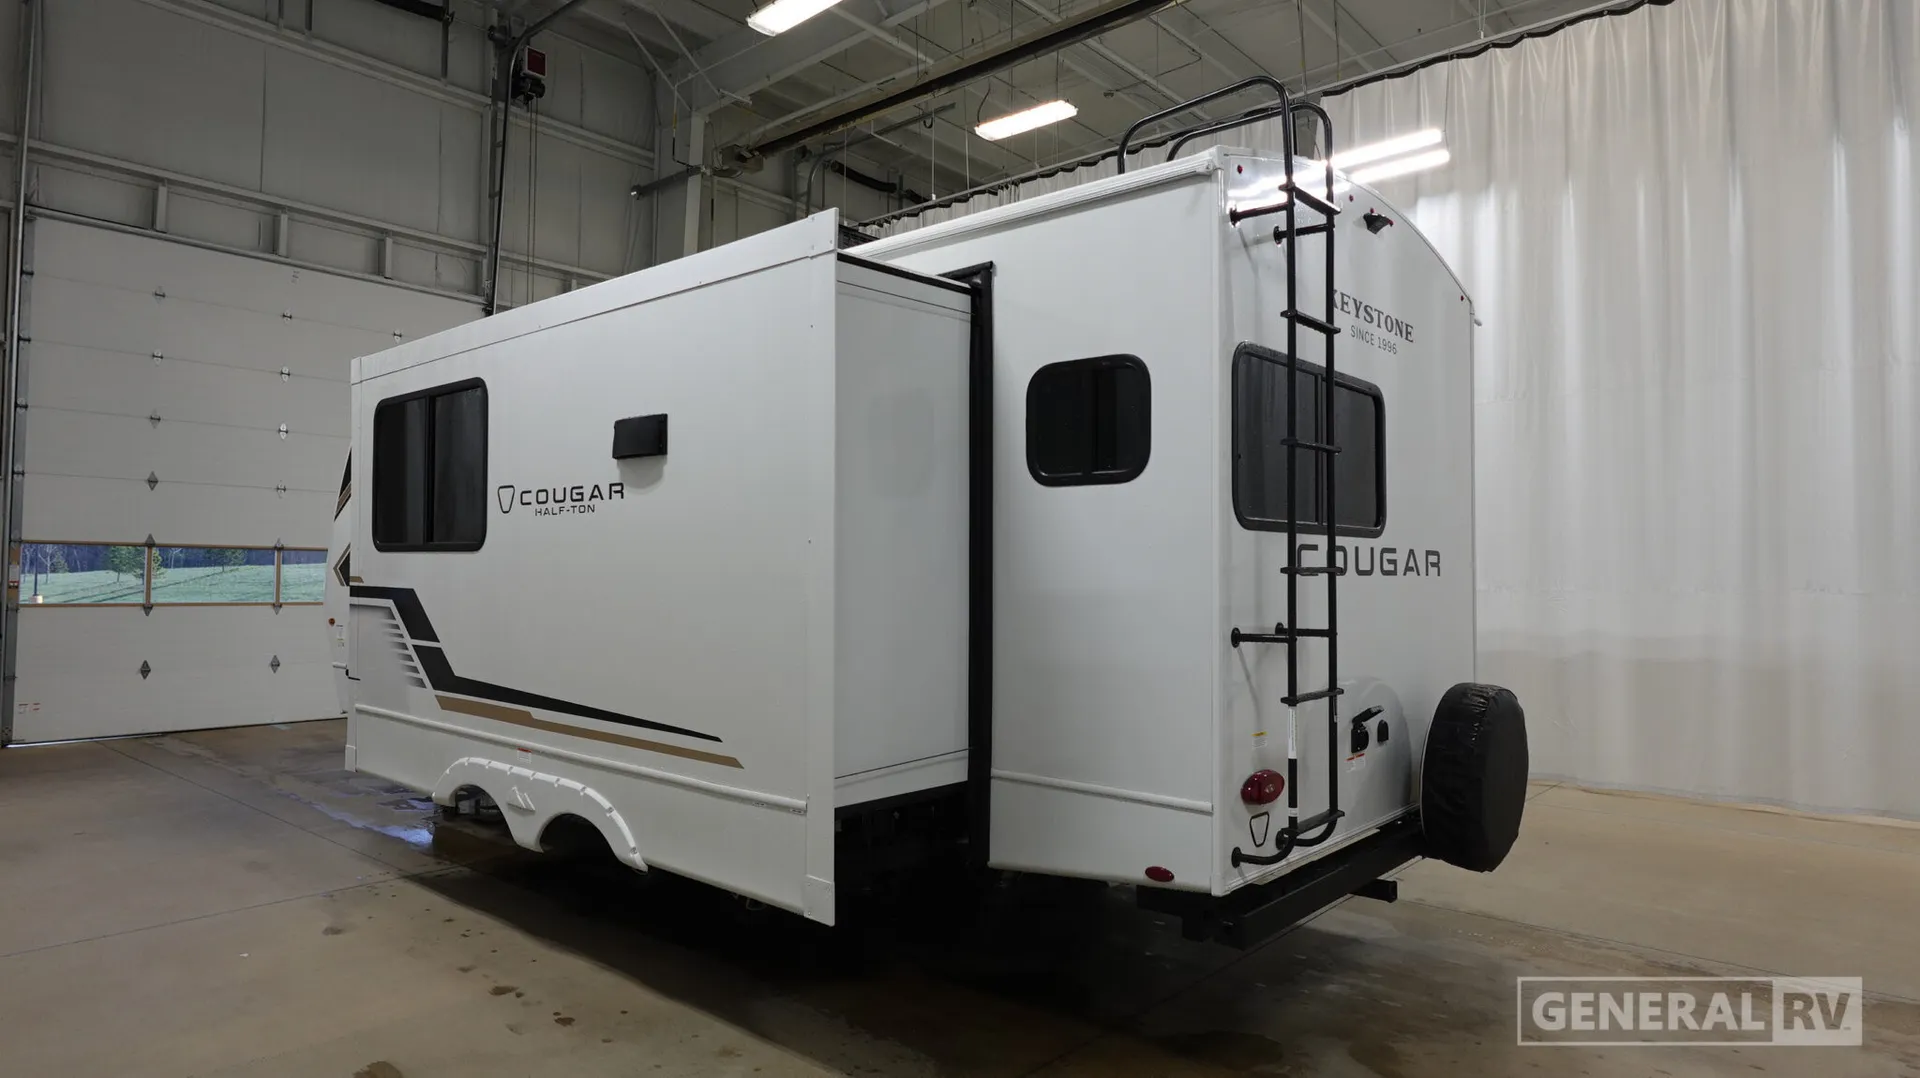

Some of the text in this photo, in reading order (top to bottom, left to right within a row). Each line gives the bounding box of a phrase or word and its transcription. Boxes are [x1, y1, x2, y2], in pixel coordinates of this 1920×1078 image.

[1350, 325, 1397, 355] SINCE 1996
[520, 482, 624, 506] COUGAR
[534, 504, 596, 517] HALF-TON
